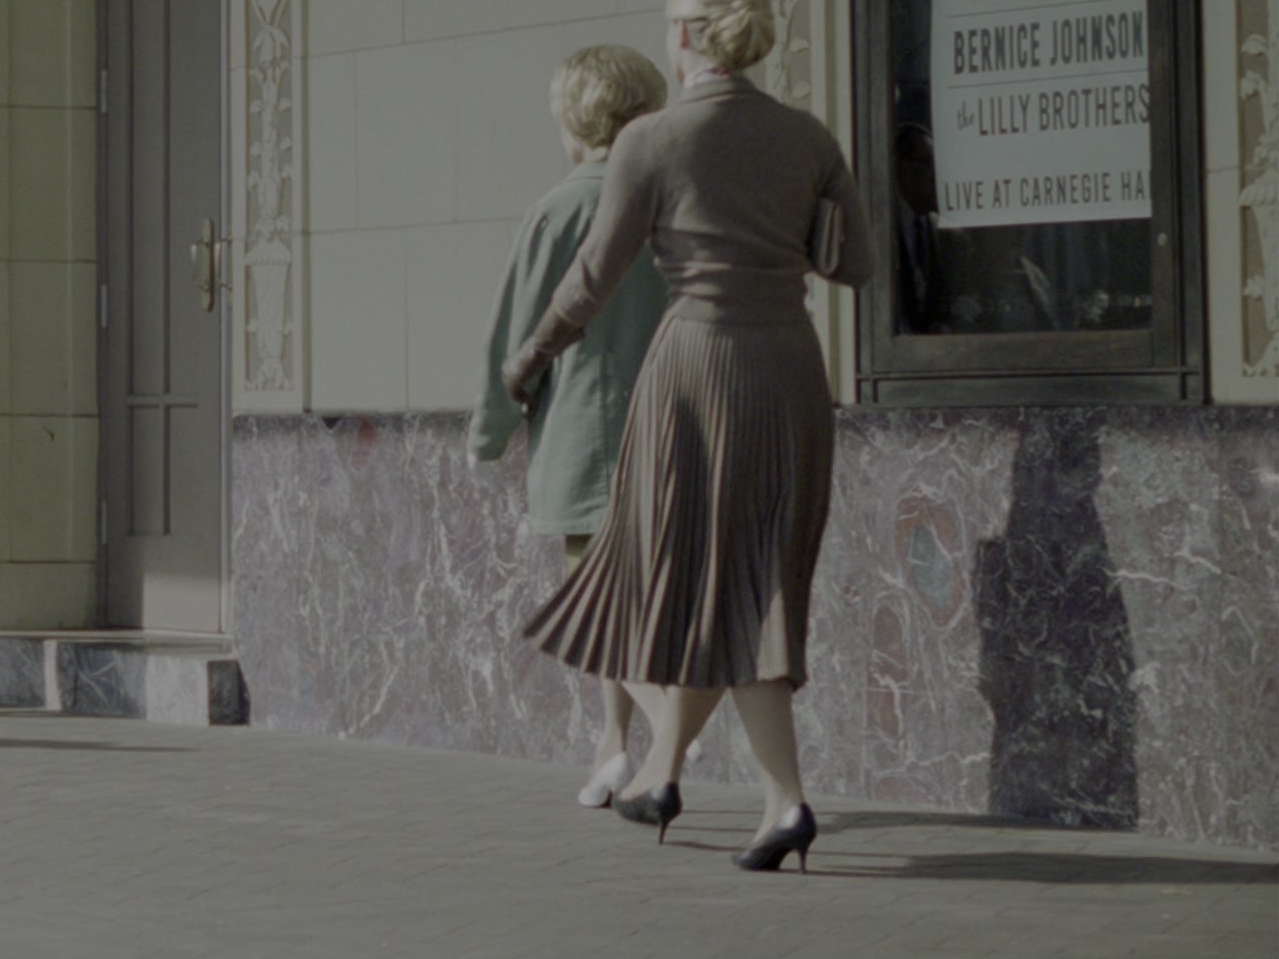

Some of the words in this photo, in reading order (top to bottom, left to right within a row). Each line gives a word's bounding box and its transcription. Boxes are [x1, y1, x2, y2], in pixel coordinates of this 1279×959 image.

[953, 21, 1041, 75] BERNICE
[1049, 10, 1144, 66] JOHNSON
[957, 100, 975, 132] the
[977, 94, 1031, 137] LILLY
[1039, 83, 1150, 132] BROTHERS
[944, 181, 984, 212] LIVE
[992, 178, 1013, 209] AT
[1019, 172, 1112, 207] CARNEGIE
[1120, 170, 1151, 201] HA
